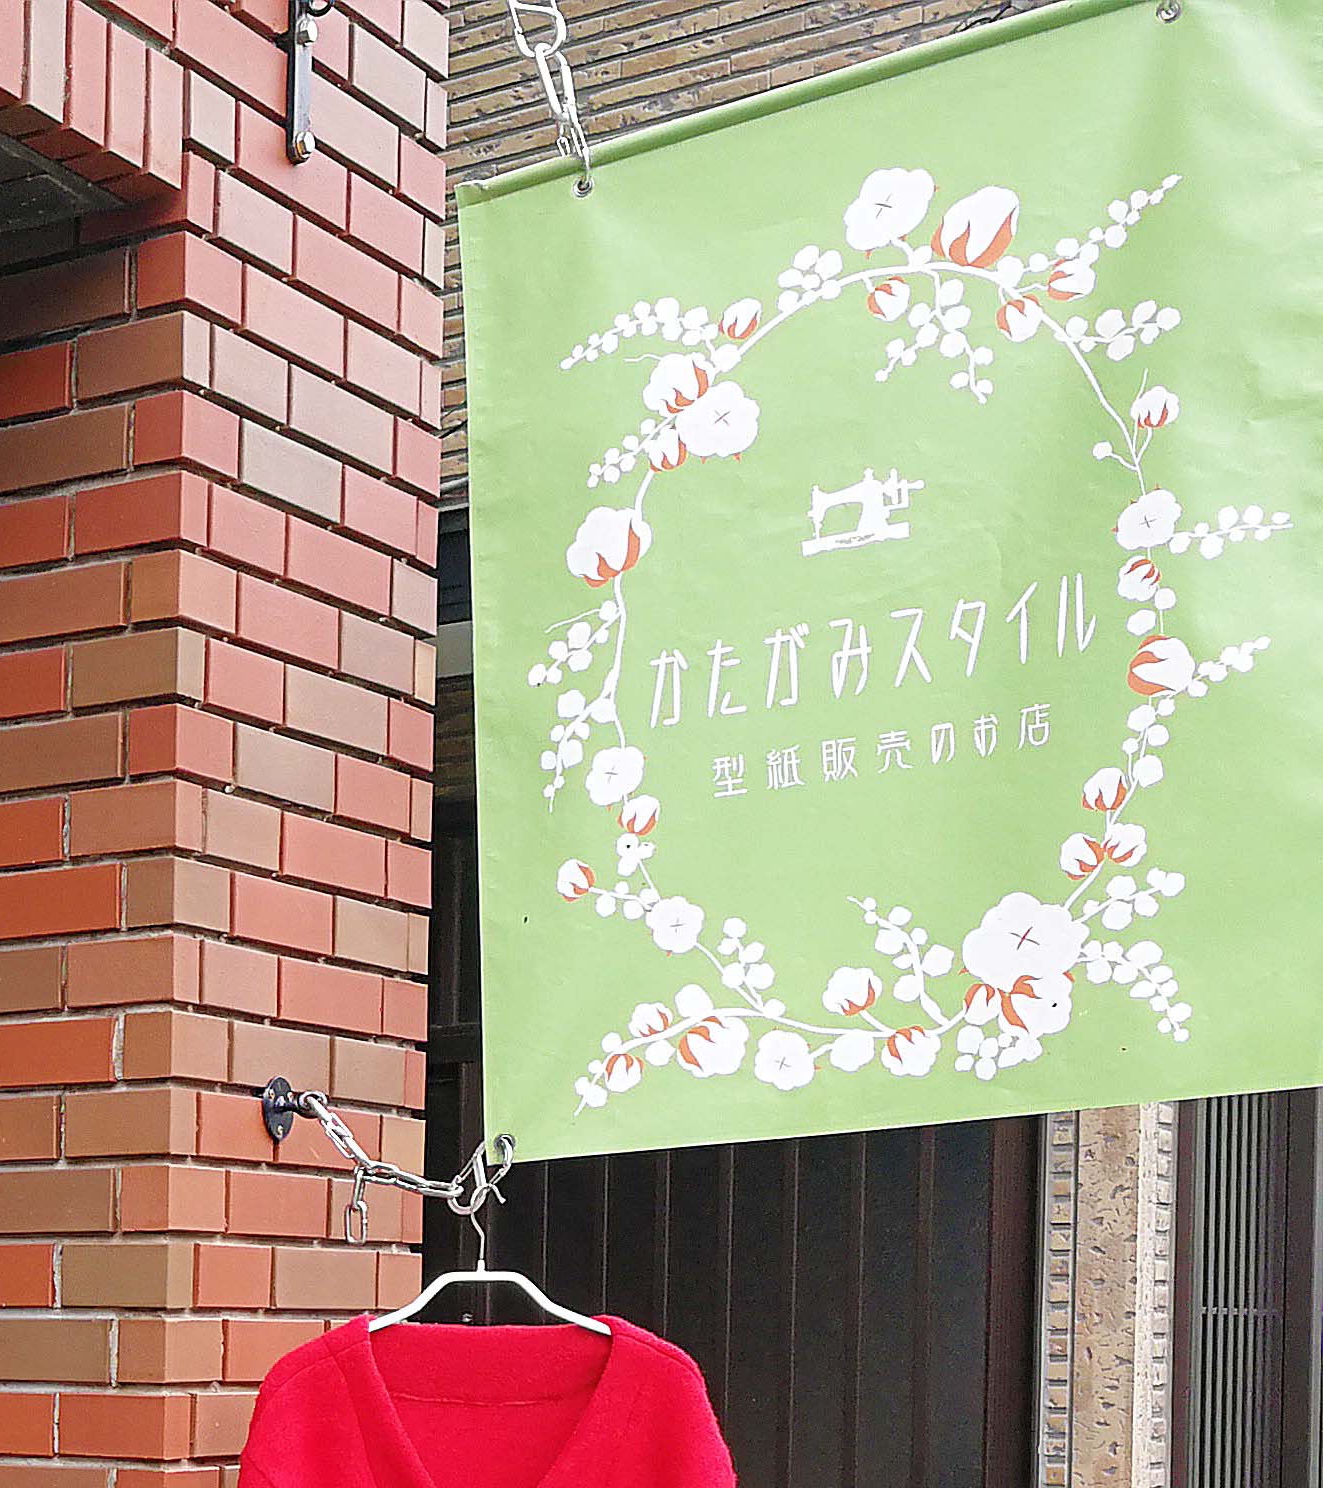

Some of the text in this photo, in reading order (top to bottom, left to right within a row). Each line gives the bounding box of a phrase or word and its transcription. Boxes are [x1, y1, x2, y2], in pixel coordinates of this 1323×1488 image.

[648, 572, 1097, 729] かたがみスタイル
[711, 703, 1052, 798] 型紙販売のお店
